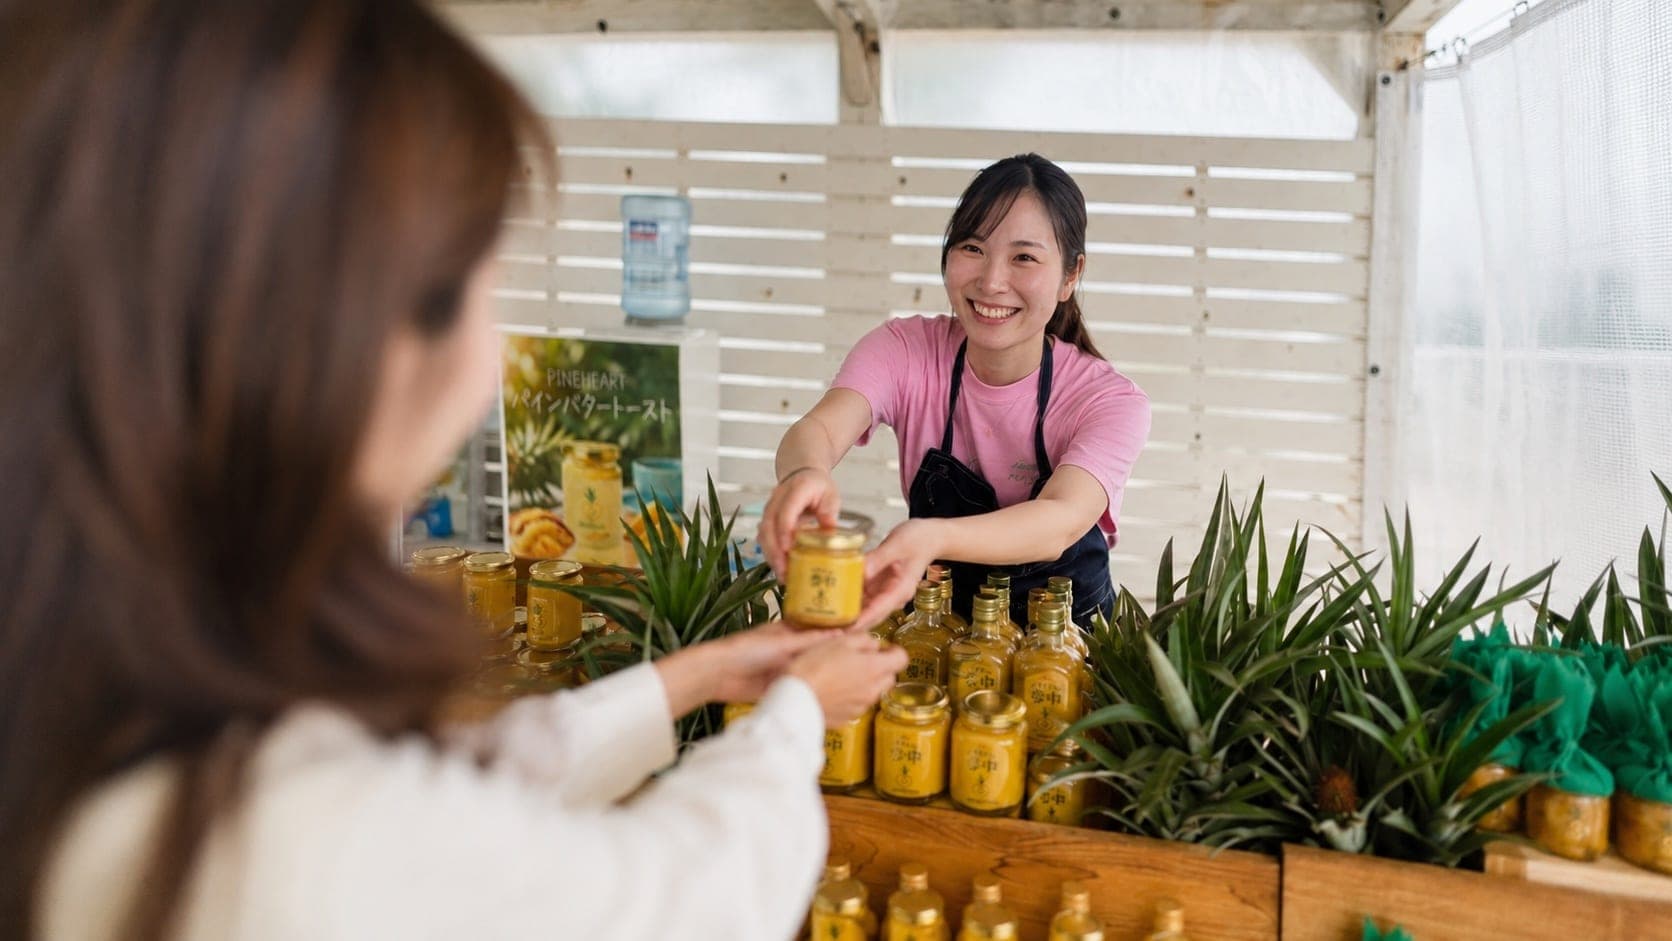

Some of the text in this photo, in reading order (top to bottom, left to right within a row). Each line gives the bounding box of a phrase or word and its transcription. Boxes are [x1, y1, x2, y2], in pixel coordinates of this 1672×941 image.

[547, 367, 625, 391] PINEHEART
[511, 388, 673, 424] パインバタートースト
